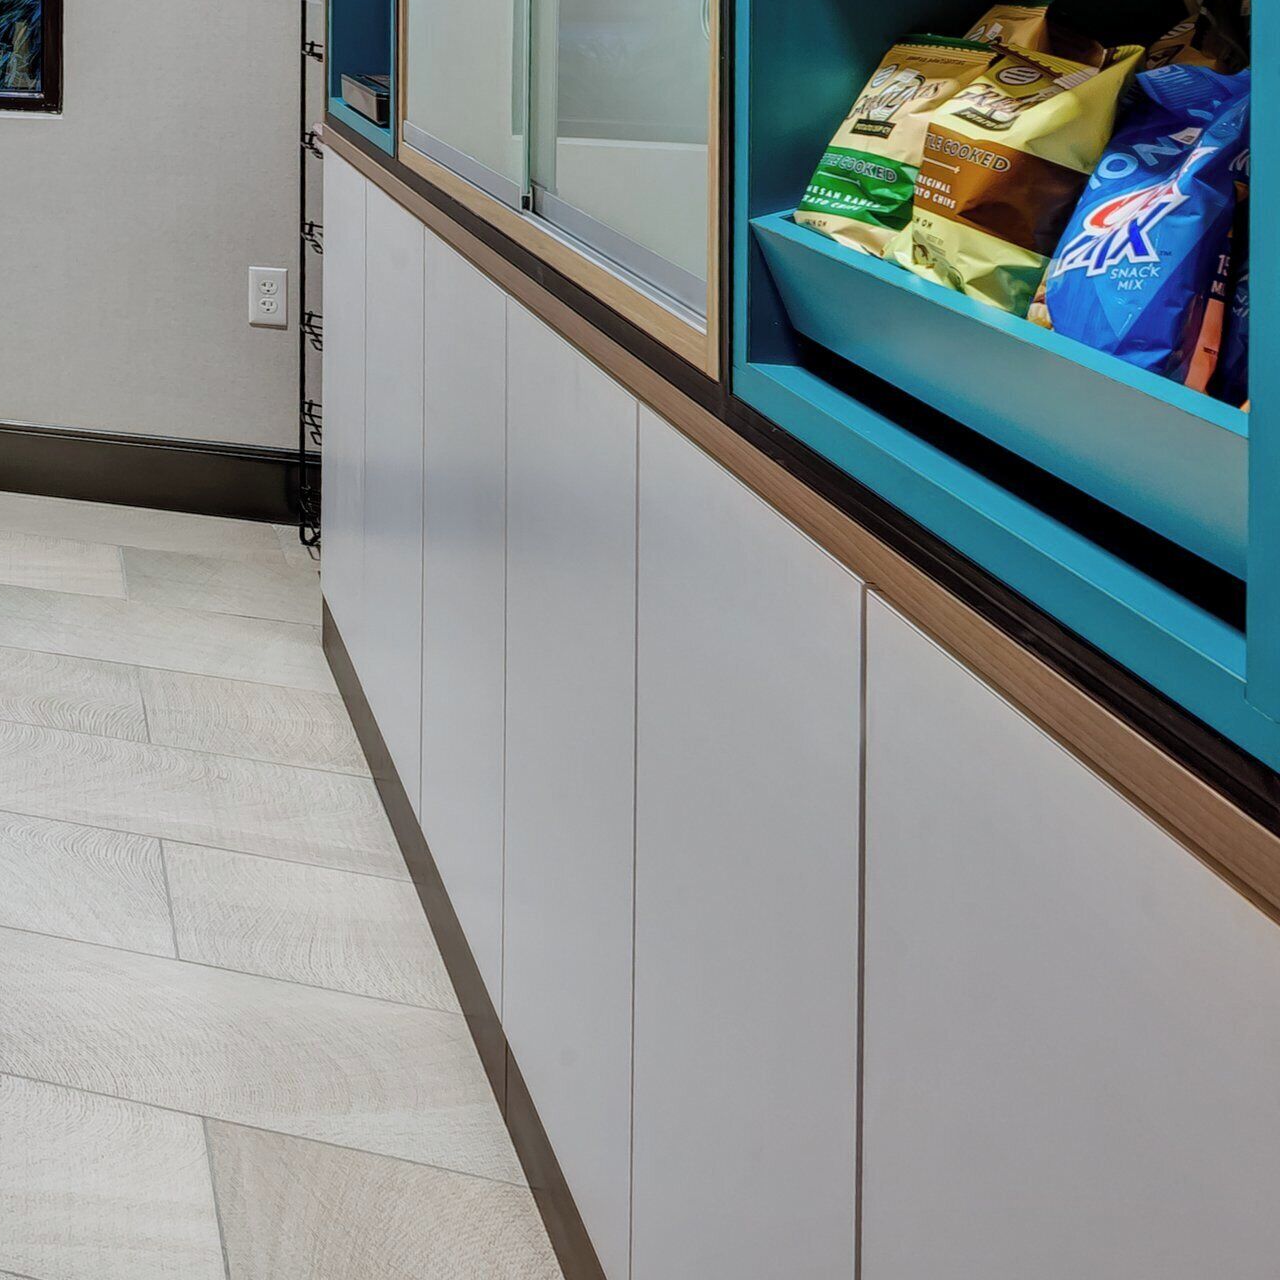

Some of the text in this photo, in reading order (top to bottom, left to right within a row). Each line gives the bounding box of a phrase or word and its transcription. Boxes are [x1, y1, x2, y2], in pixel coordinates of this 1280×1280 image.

[942, 135, 1011, 173] COOKED
[840, 156, 897, 184] COOKED
[916, 174, 951, 195] RIGINAL
[932, 193, 957, 210] CHIPS
[1109, 263, 1161, 280] SNACK
[1116, 279, 1144, 292] MIX
